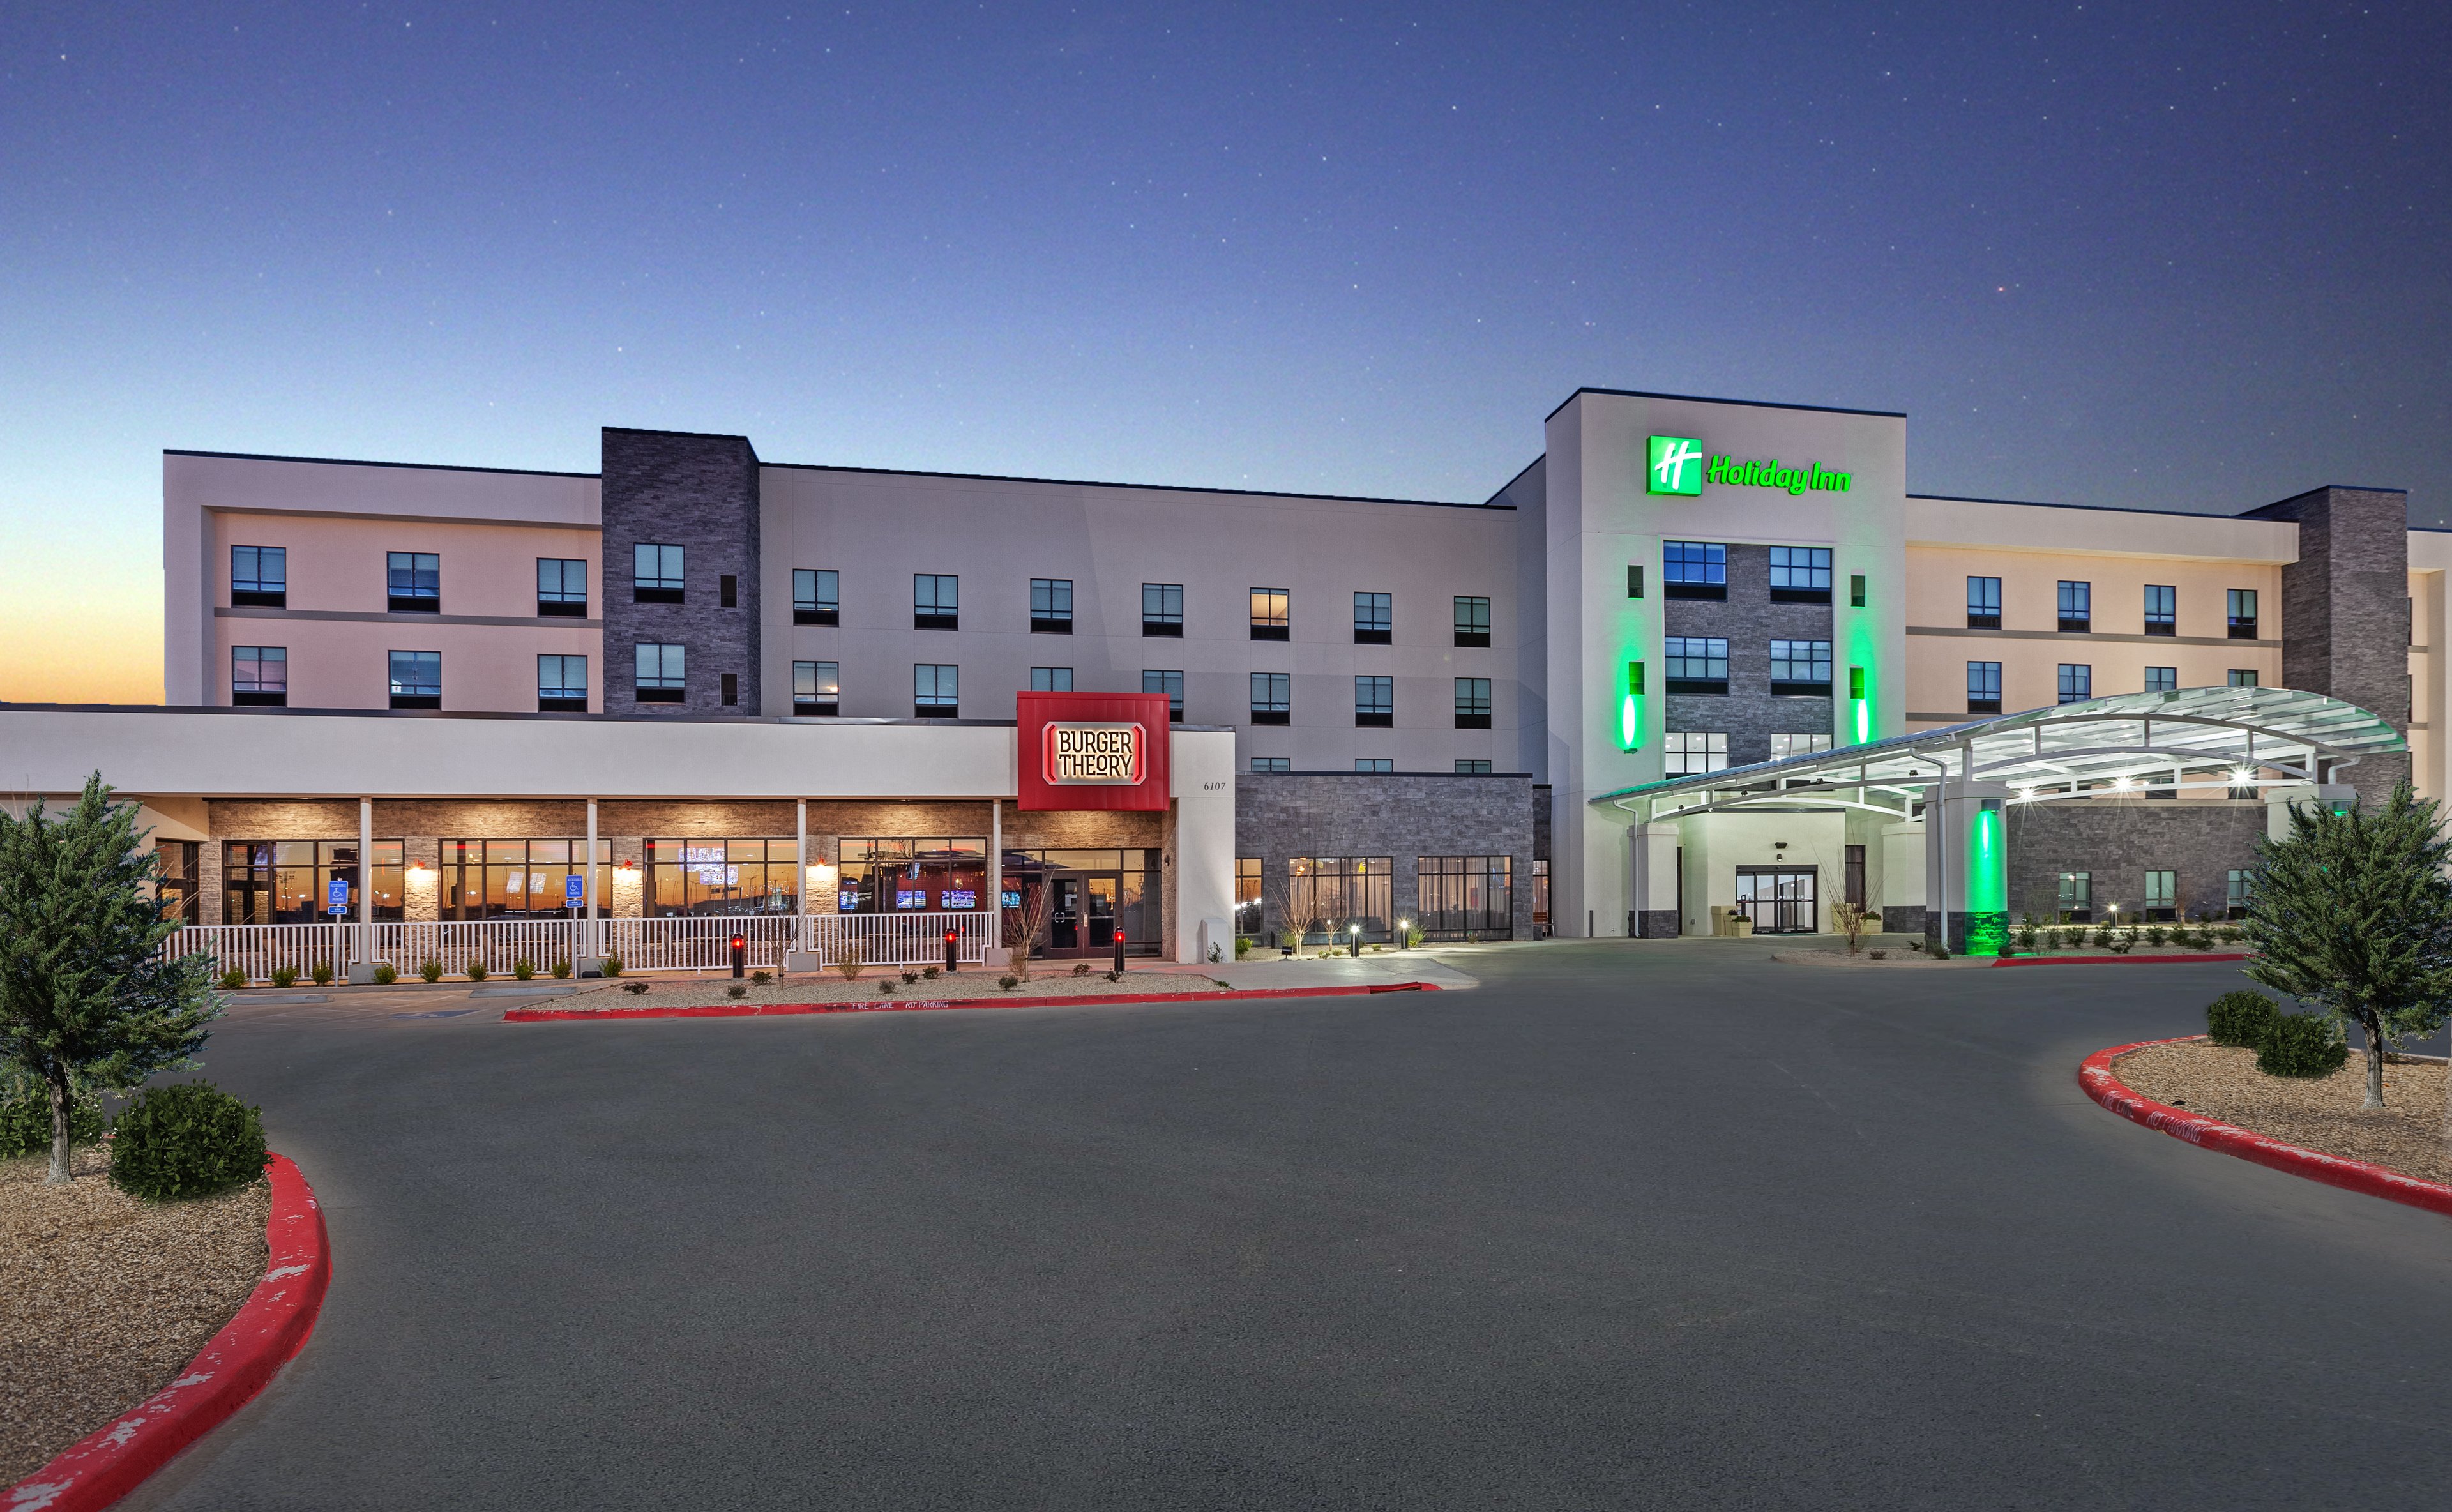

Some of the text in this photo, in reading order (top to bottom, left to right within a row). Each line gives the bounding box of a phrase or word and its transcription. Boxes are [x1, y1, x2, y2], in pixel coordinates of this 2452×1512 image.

[1707, 454, 1809, 495] Holiday
[1810, 461, 1851, 492] Inn
[1059, 730, 1133, 753] BURGER
[1059, 754, 1133, 776] THEORY
[1204, 782, 1226, 791] 6107
[2146, 1111, 2166, 1126] NO
[2162, 1116, 2209, 1144] PARKING
